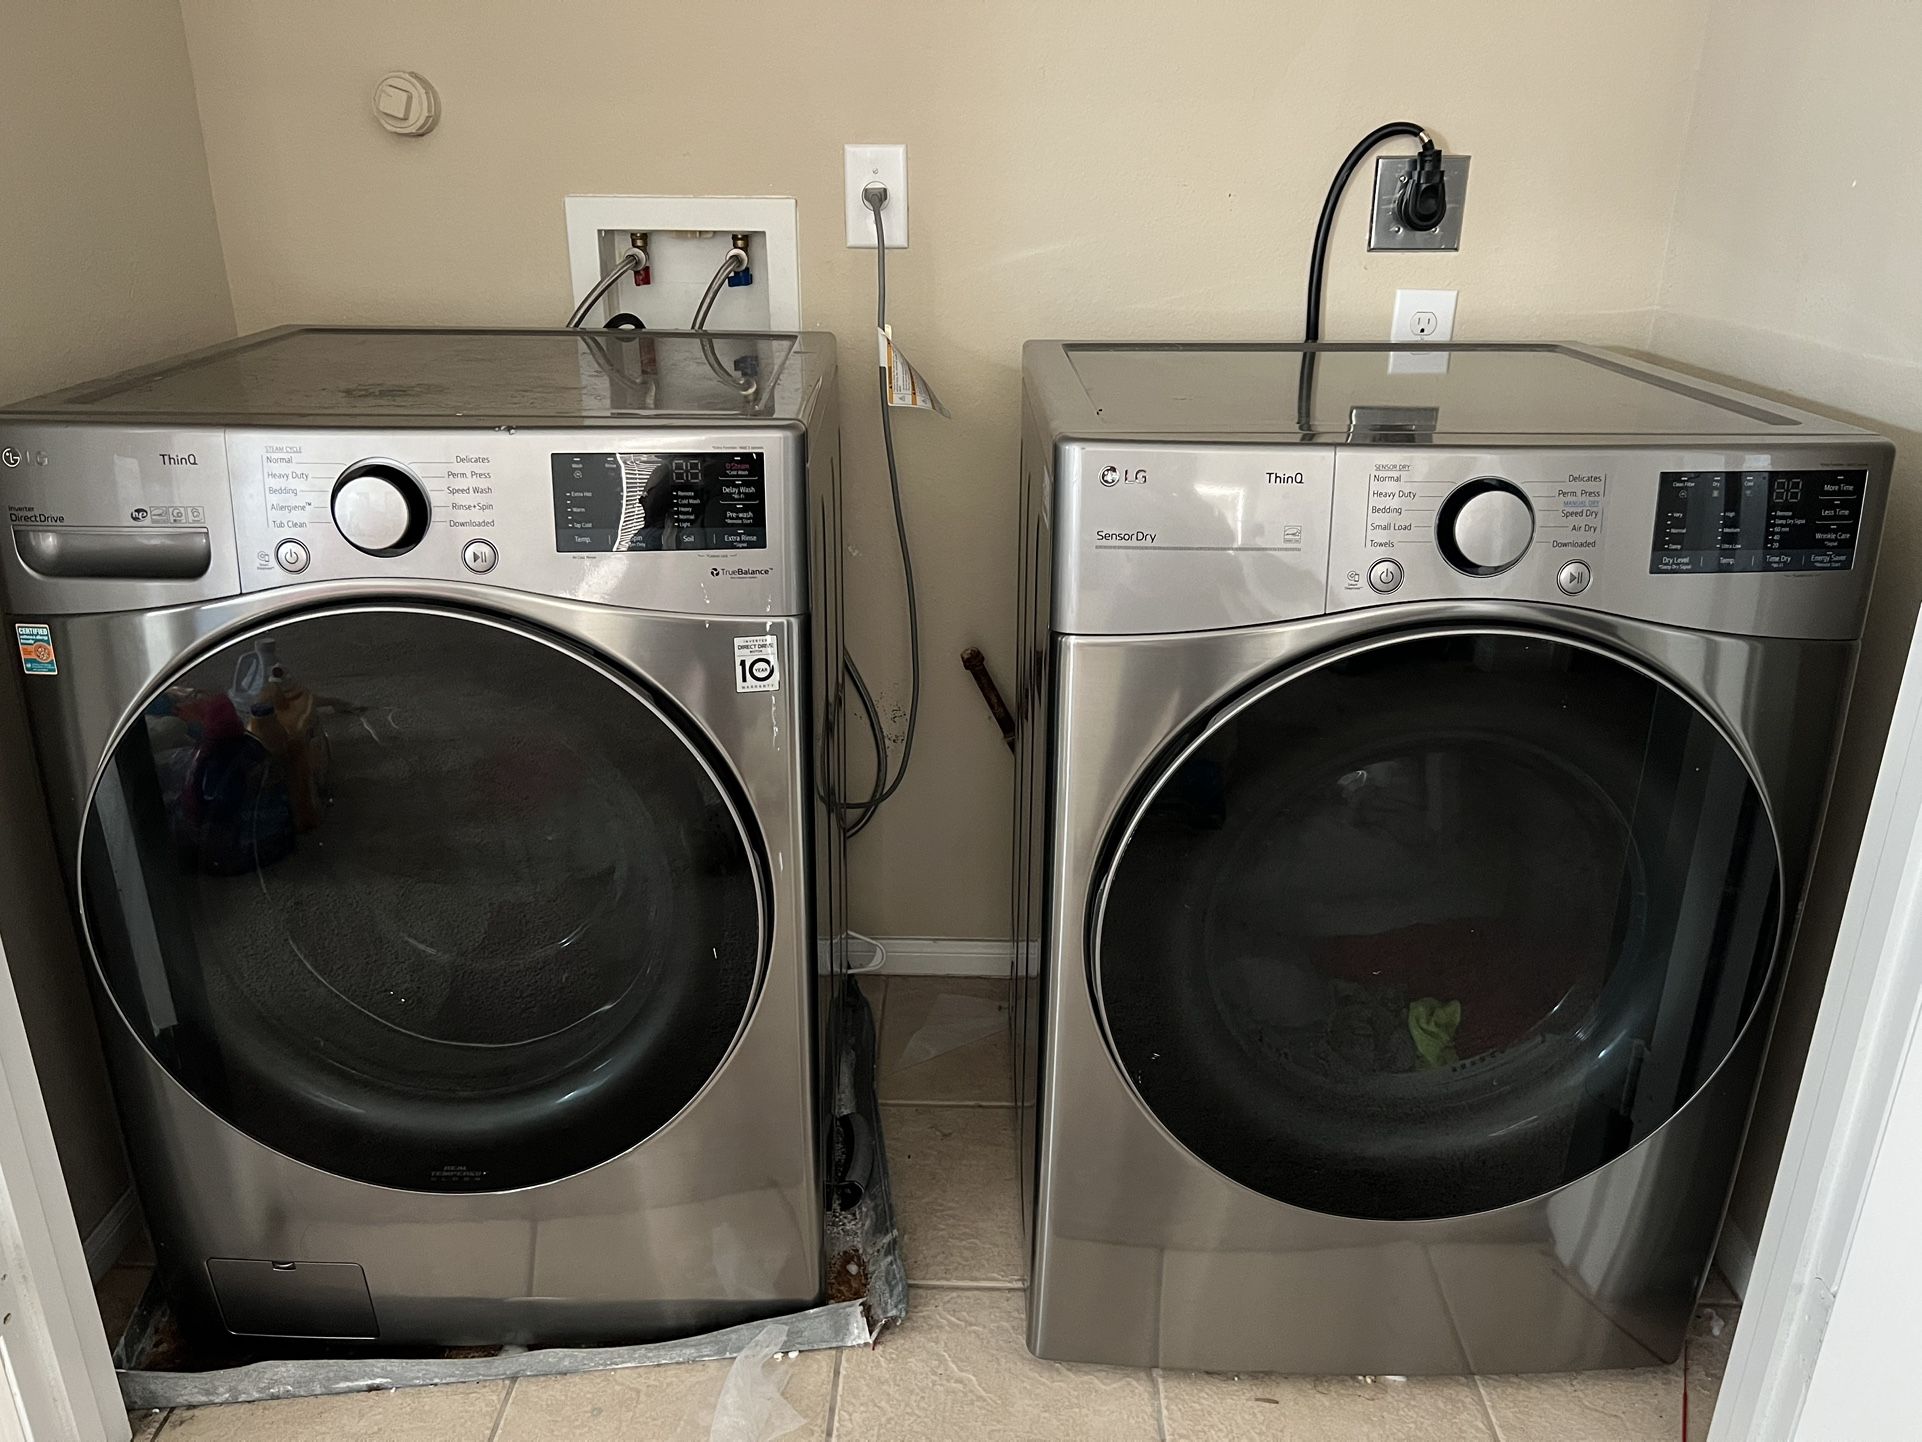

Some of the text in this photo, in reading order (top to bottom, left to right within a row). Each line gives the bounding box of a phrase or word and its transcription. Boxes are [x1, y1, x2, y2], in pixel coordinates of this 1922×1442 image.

[159, 453, 198, 466] ThinQ
[266, 456, 293, 464] Normal
[455, 455, 490, 464] Delicates
[267, 471, 309, 480] Heavy Duty
[447, 470, 491, 479] Perm. Press
[1124, 469, 1147, 484] LG
[1265, 472, 1305, 485] ThinQ
[1373, 474, 1402, 482] Normal
[1568, 474, 1602, 482] Delicates
[269, 487, 298, 496] Bedding
[447, 486, 493, 496] Speed Wash
[1372, 490, 1417, 500] Heavy Duty
[1558, 489, 1601, 498] Perm. Press
[1371, 506, 1402, 516] Bedding
[1561, 509, 1599, 519] Speed Dry
[272, 520, 307, 529] Tub Clean
[449, 519, 495, 528] Downloaded
[1370, 523, 1412, 531] Small Load
[1571, 524, 1597, 534] Air Dry
[1370, 540, 1395, 548] Towels
[1552, 539, 1596, 548] Downloaded
[1780, 555, 1791, 563] Dry
[18, 627, 48, 635] CERTIFIED
[739, 657, 774, 683] 10
